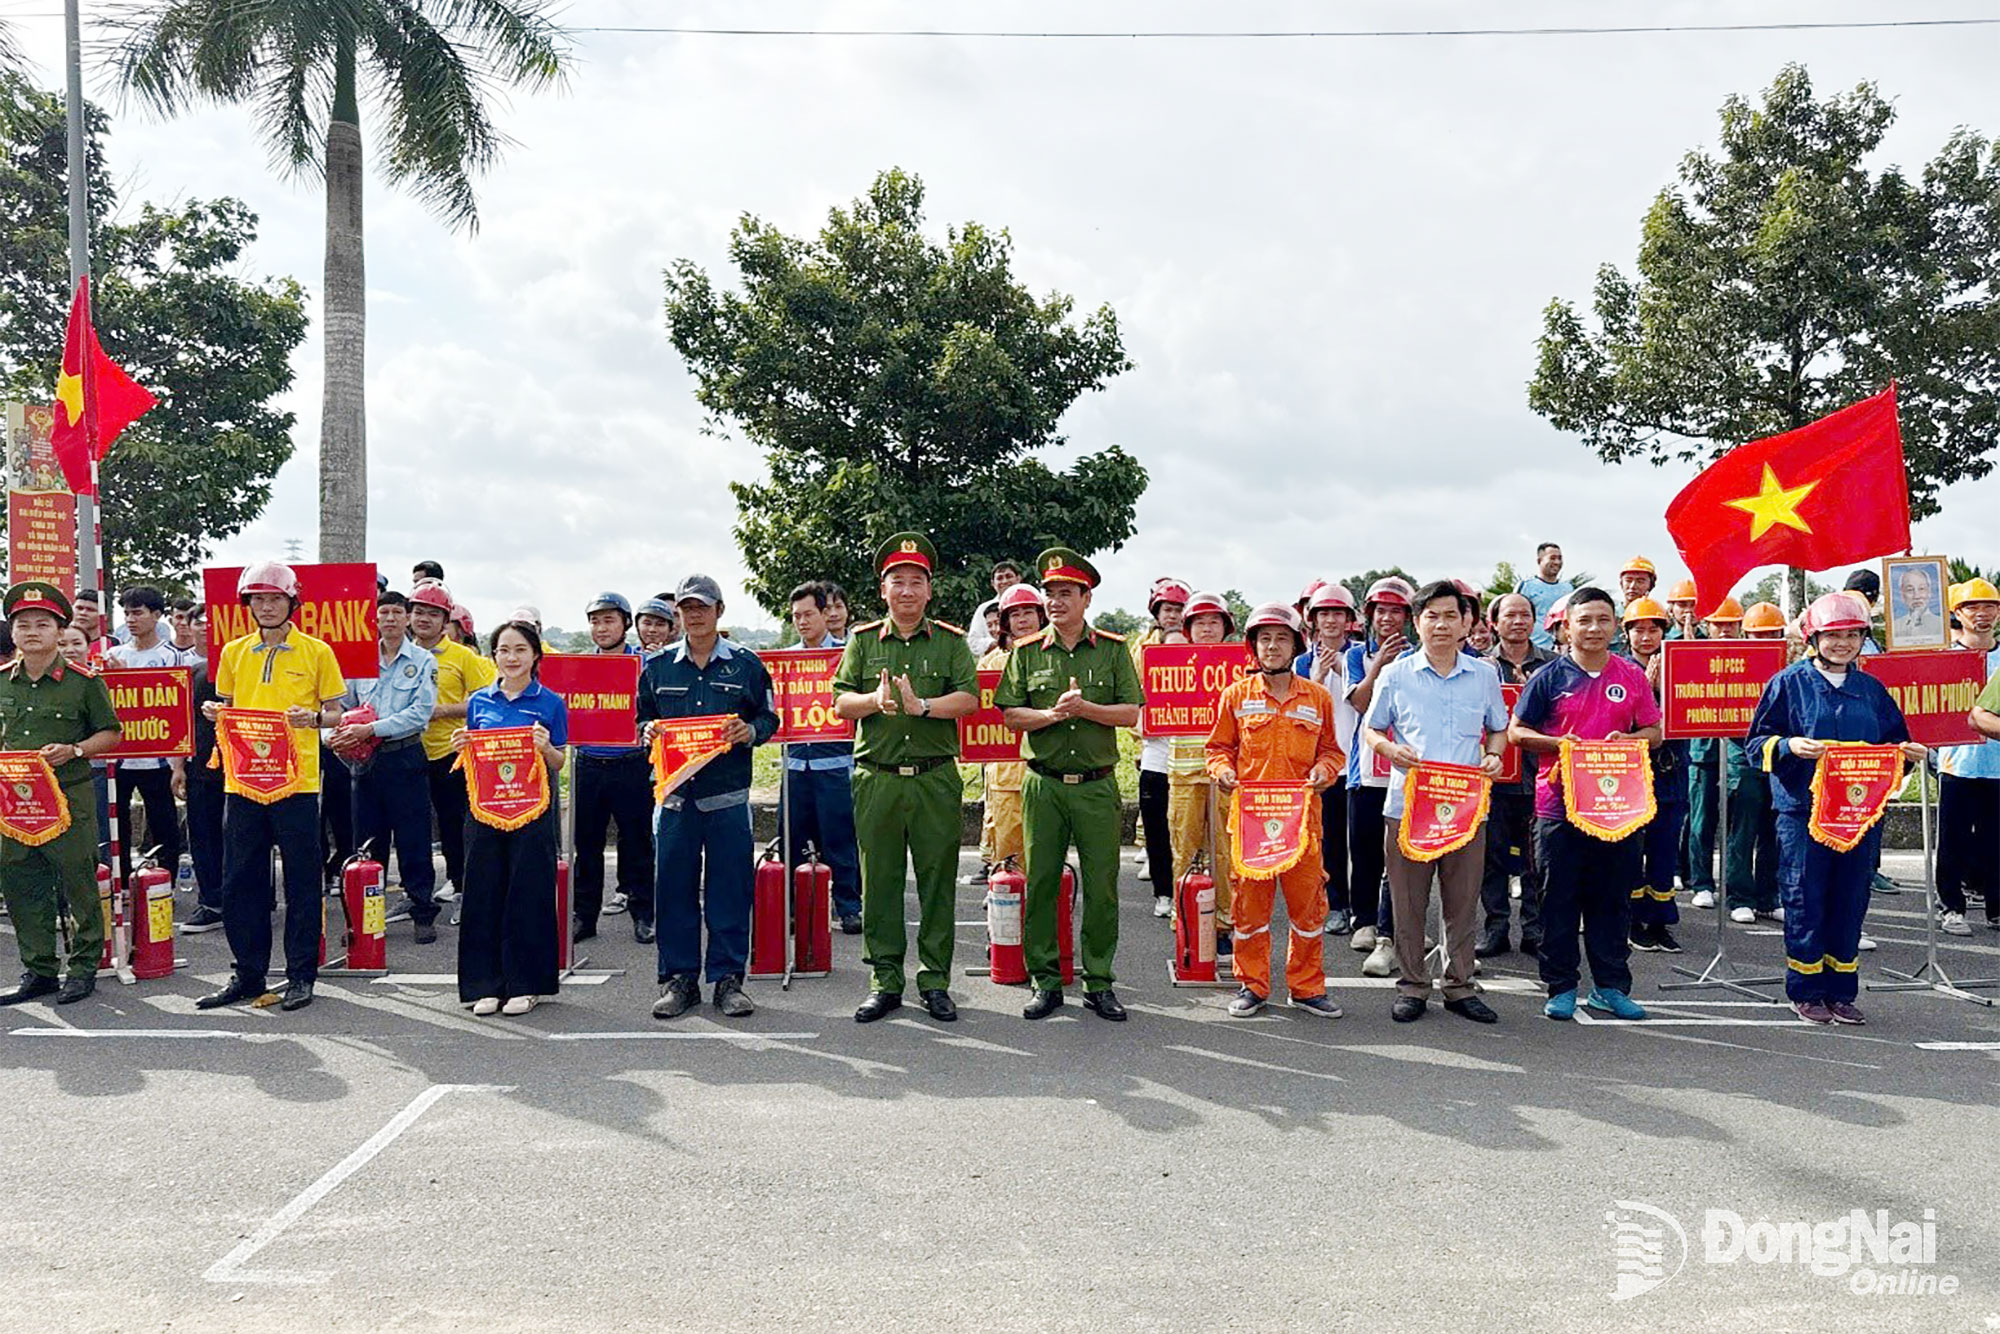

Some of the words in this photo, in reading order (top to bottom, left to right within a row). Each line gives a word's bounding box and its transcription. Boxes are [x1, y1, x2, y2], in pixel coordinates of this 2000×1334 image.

[301, 600, 373, 642] BANK
[778, 660, 792, 676] TY
[795, 658, 827, 674] TNHH
[1149, 653, 1197, 693] THUẾ
[1203, 661, 1227, 693] CƠ
[143, 682, 178, 708] DÂN
[567, 693, 596, 709] LONG
[792, 700, 843, 733] LỘC
[1150, 702, 1189, 726] THÀNH
[1192, 698, 1215, 725] PHỐ
[120, 715, 170, 741] HƯỚC
[966, 724, 1016, 746] LONG
